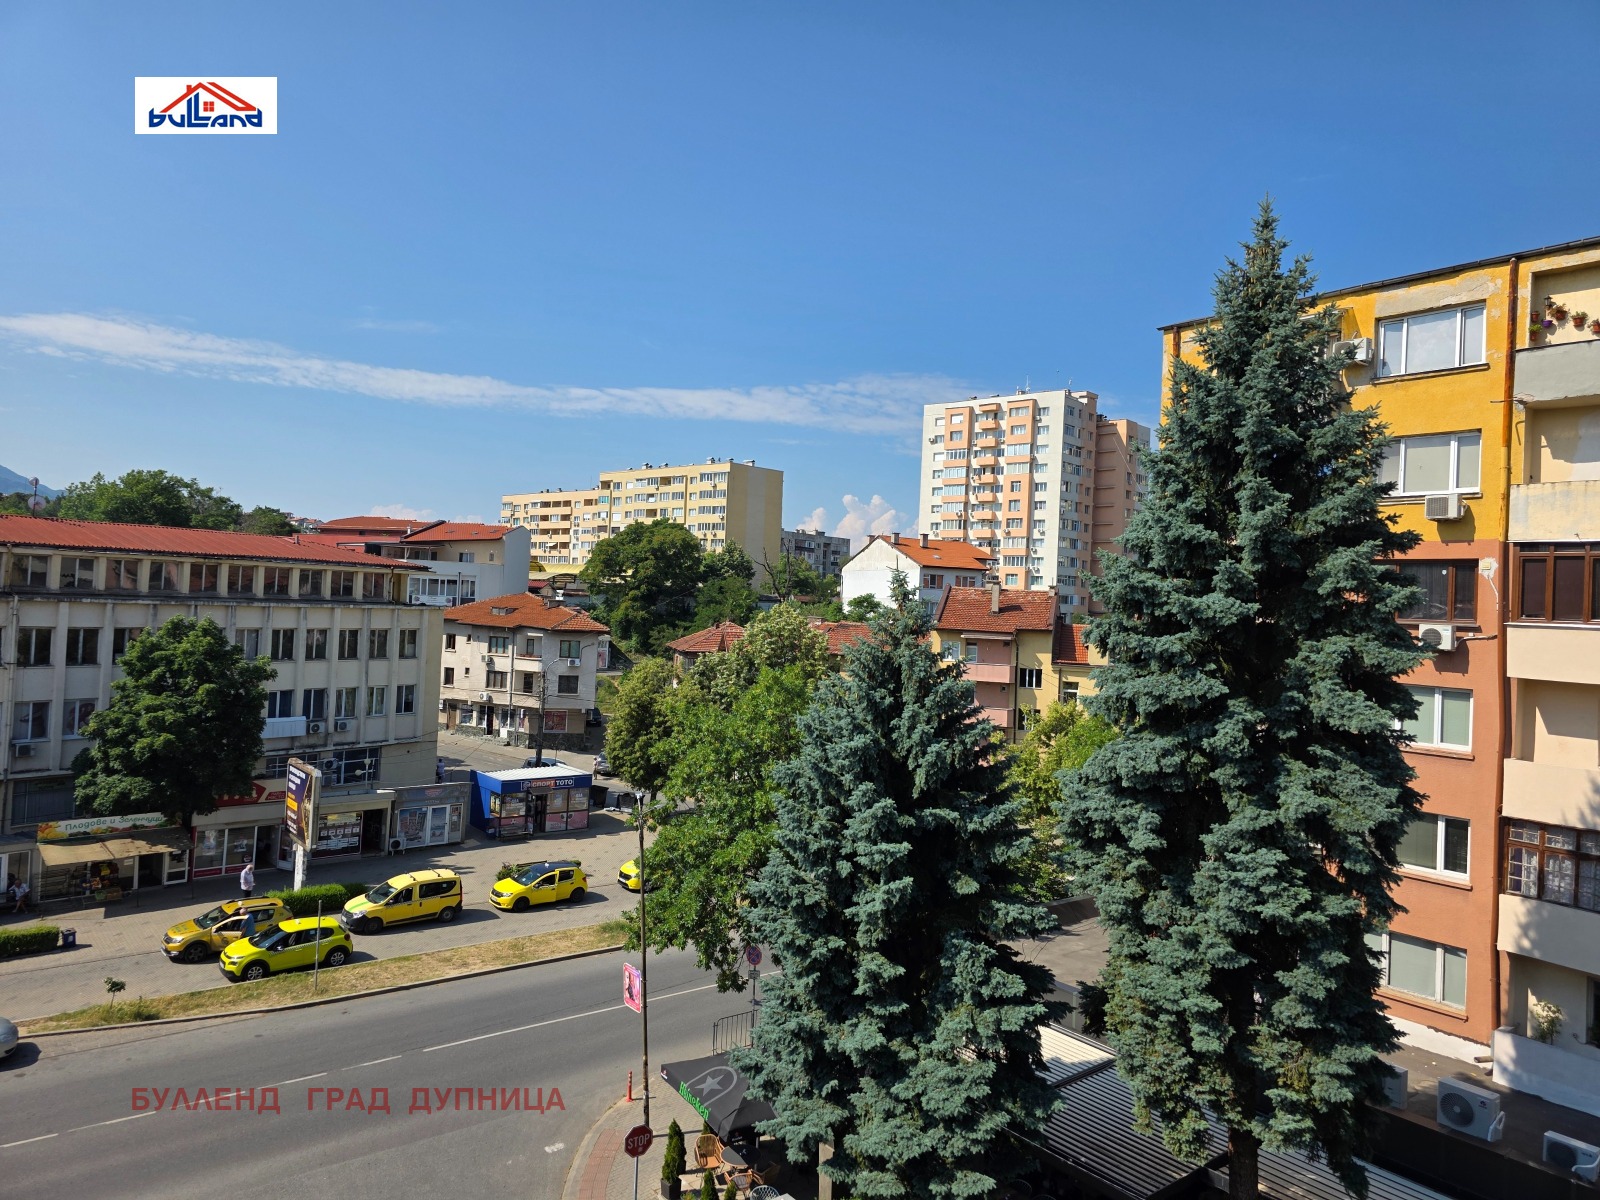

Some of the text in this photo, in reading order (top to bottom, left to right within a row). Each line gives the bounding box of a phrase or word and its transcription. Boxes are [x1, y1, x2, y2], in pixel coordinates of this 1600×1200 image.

[65, 819, 107, 831] Плодове
[119, 816, 163, 826] Зеленчуци
[679, 1081, 709, 1120] Heineken
[627, 1133, 650, 1149] STOP
